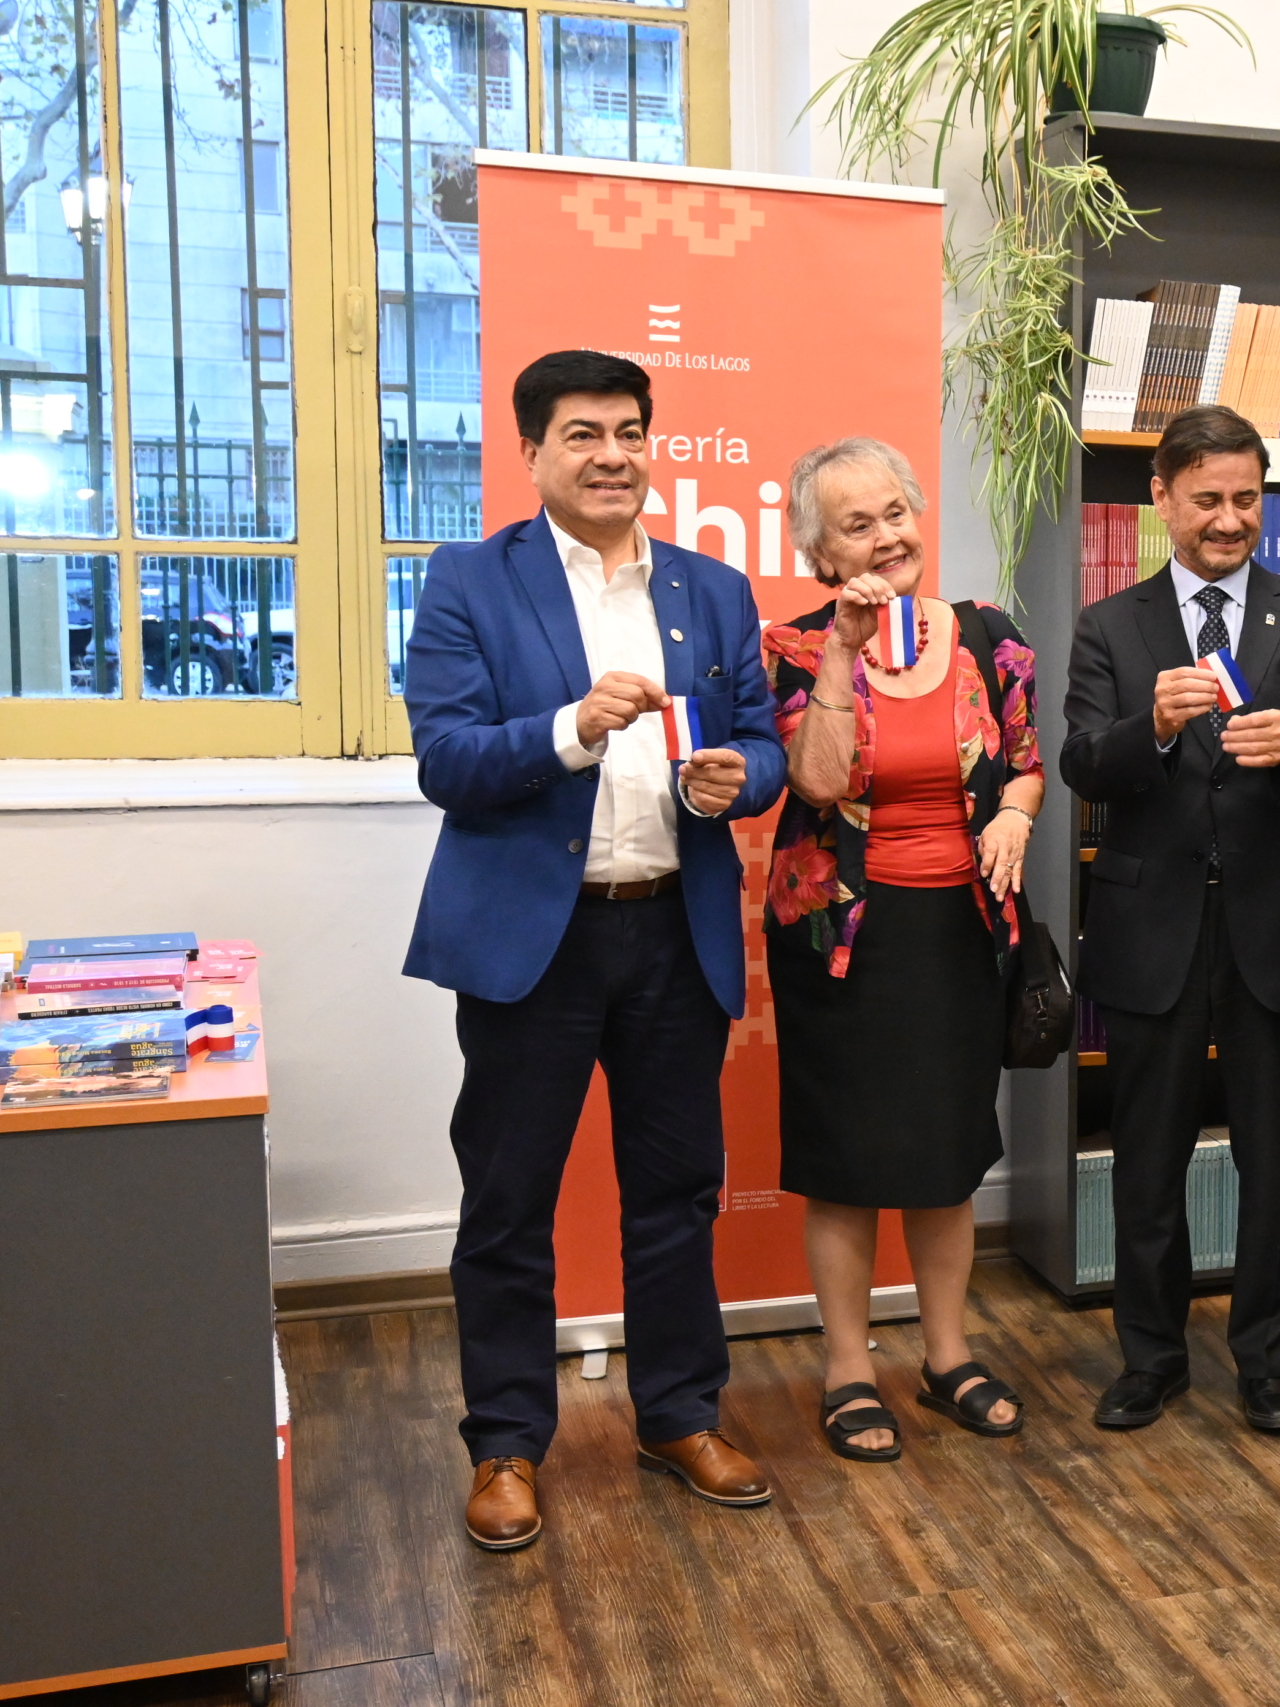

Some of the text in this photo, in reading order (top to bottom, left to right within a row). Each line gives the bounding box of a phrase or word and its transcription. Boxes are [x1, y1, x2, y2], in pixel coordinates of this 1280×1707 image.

[685, 353, 708, 369] LOS
[711, 354, 750, 371] LAGOS
[650, 427, 749, 464] rería
[130, 1042, 154, 1051] agua
[132, 1058, 154, 1067] agua
